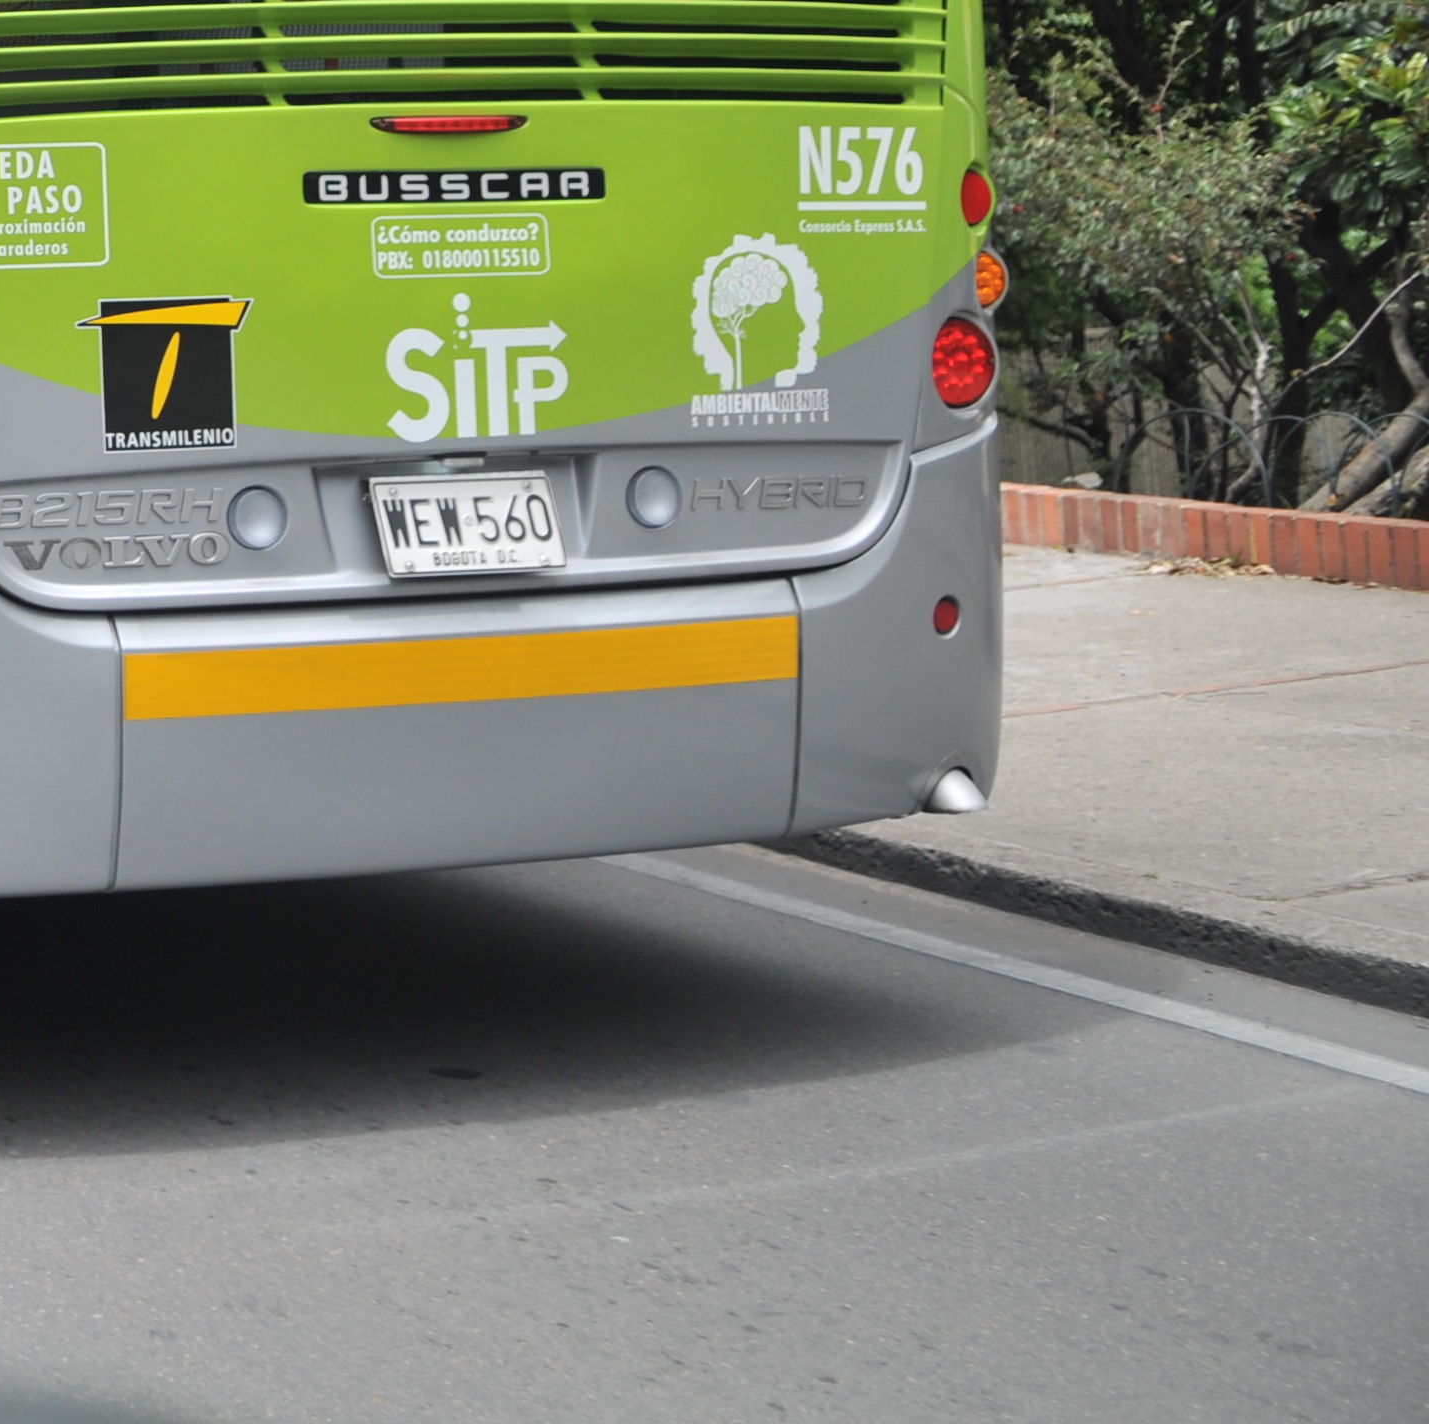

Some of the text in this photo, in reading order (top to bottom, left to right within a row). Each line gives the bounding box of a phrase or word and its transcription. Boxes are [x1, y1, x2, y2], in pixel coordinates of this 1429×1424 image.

[798, 125, 923, 195] N576
[7, 184, 82, 214] PASO
[318, 171, 590, 202] BUSSCAR
[377, 222, 539, 244] ¿Cómo conduzco?
[798, 219, 927, 235] Consorcio Express S.A.S.
[377, 248, 540, 270] PBX: 018000115510
[691, 411, 829, 427] SOSTENIBLE
[105, 428, 234, 449] TRANSMILENIO
[690, 475, 869, 511] HYBRID
[382, 493, 553, 549] WEW 560
[3, 531, 230, 571] VOLVO
[432, 551, 488, 566] BOGOTA
